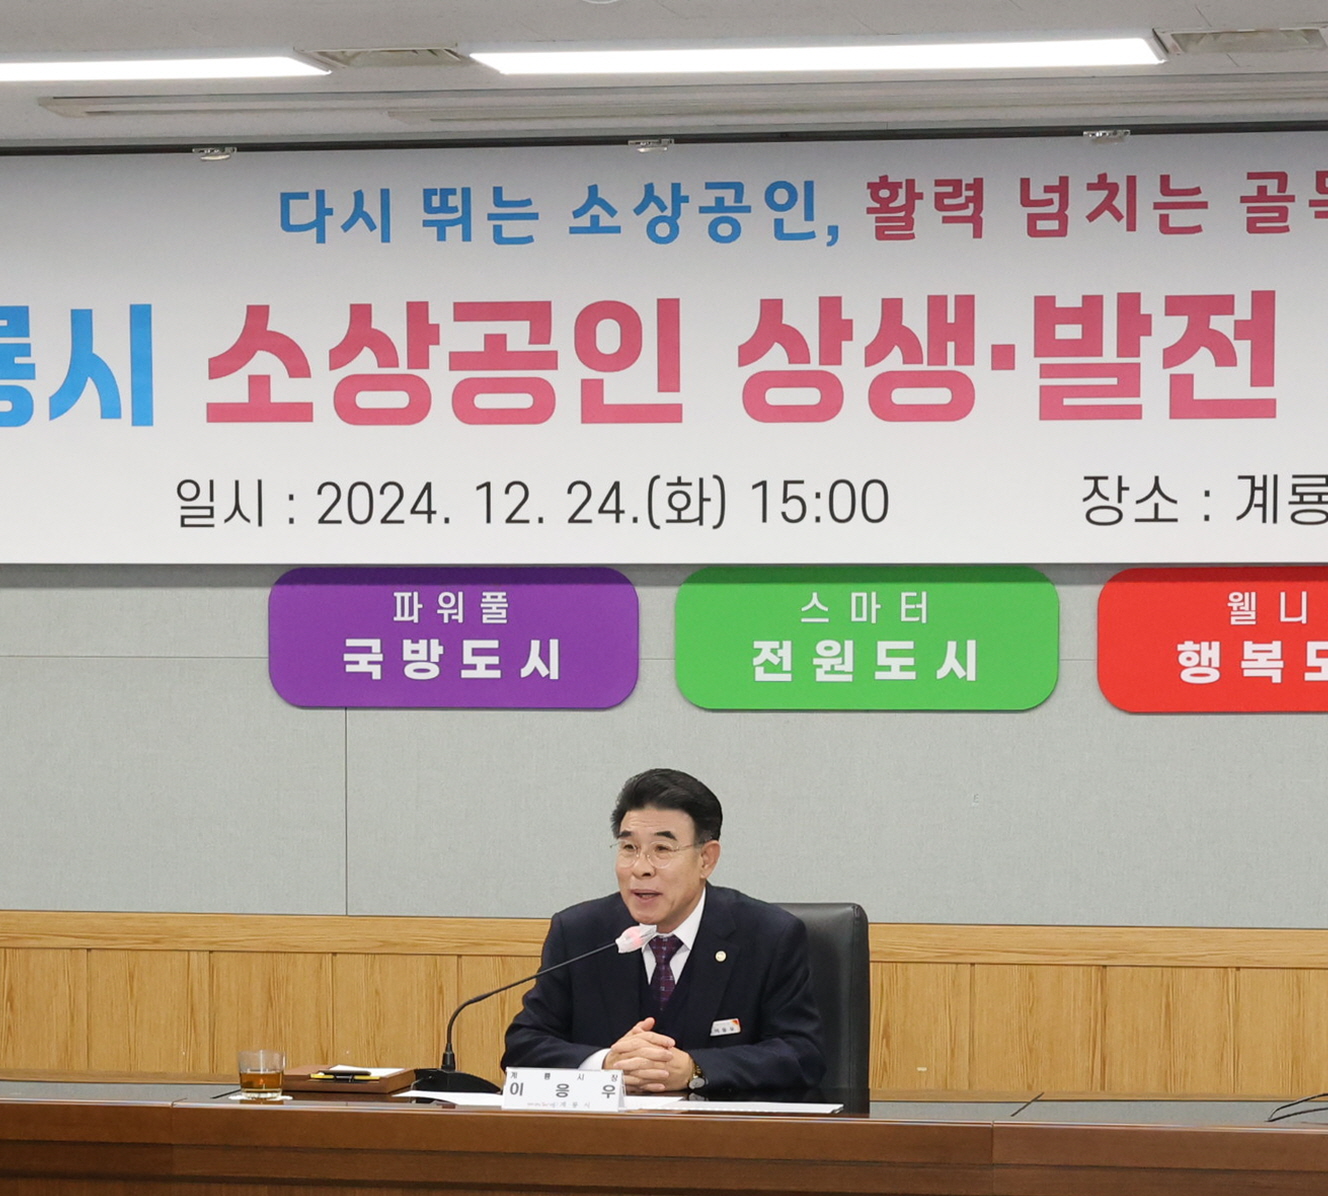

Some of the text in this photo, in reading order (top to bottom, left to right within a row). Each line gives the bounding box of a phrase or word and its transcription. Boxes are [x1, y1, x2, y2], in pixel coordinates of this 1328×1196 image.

[279, 187, 391, 244] 다시
[422, 185, 540, 246] 뛰는
[568, 179, 839, 247] 소상공인,
[866, 174, 984, 241] 활력
[1019, 172, 1209, 238] 넘치는
[206, 297, 683, 426] 소상공인
[176, 478, 263, 528] 일시
[316, 480, 450, 525] 2024.
[475, 480, 545, 524] 12.
[565, 474, 727, 530] 24.(화)
[751, 478, 889, 524] 15:00
[1082, 474, 1179, 527] 장소
[343, 638, 559, 680] 국방도시
[752, 639, 977, 682] 전원도시
